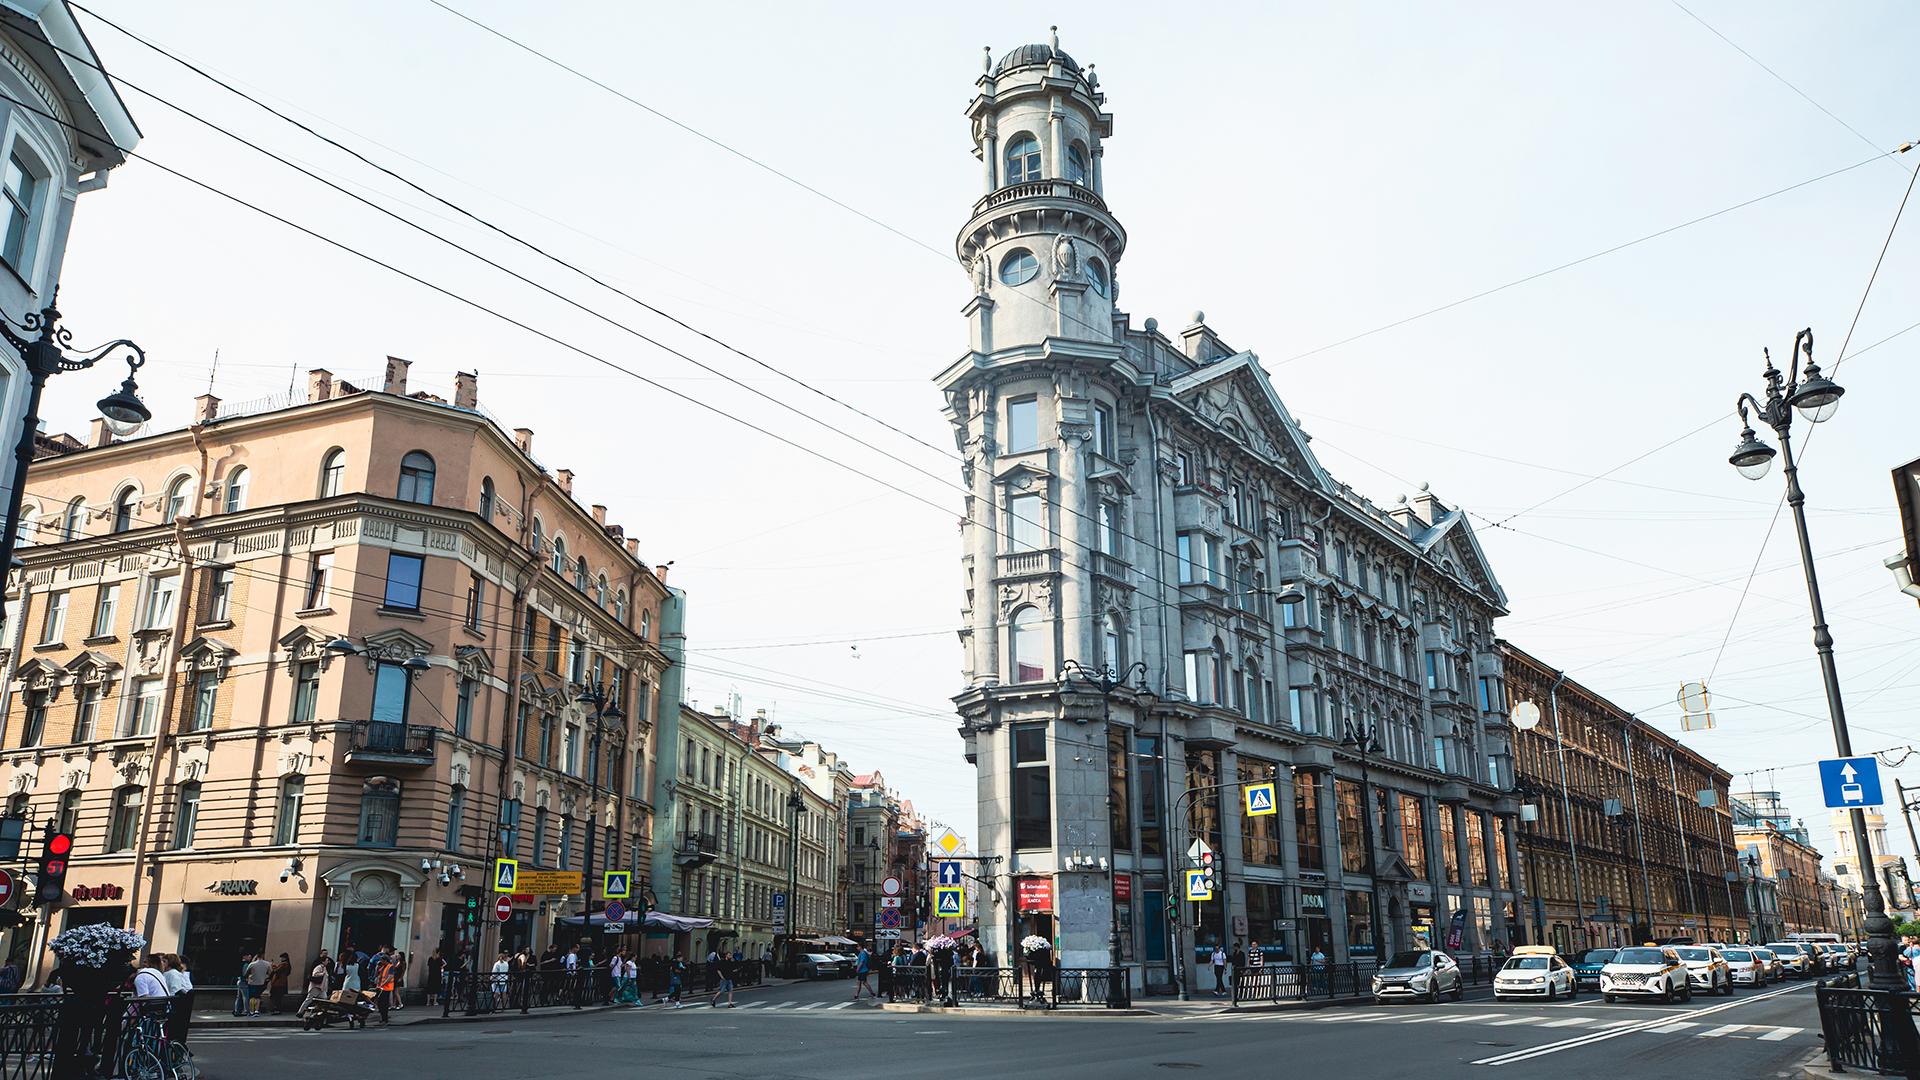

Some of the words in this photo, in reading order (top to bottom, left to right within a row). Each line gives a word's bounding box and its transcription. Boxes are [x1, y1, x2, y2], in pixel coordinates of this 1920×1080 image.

[47, 860, 65, 874] 57
[220, 880, 255, 895] FRANK
[776, 895, 784, 906] P
